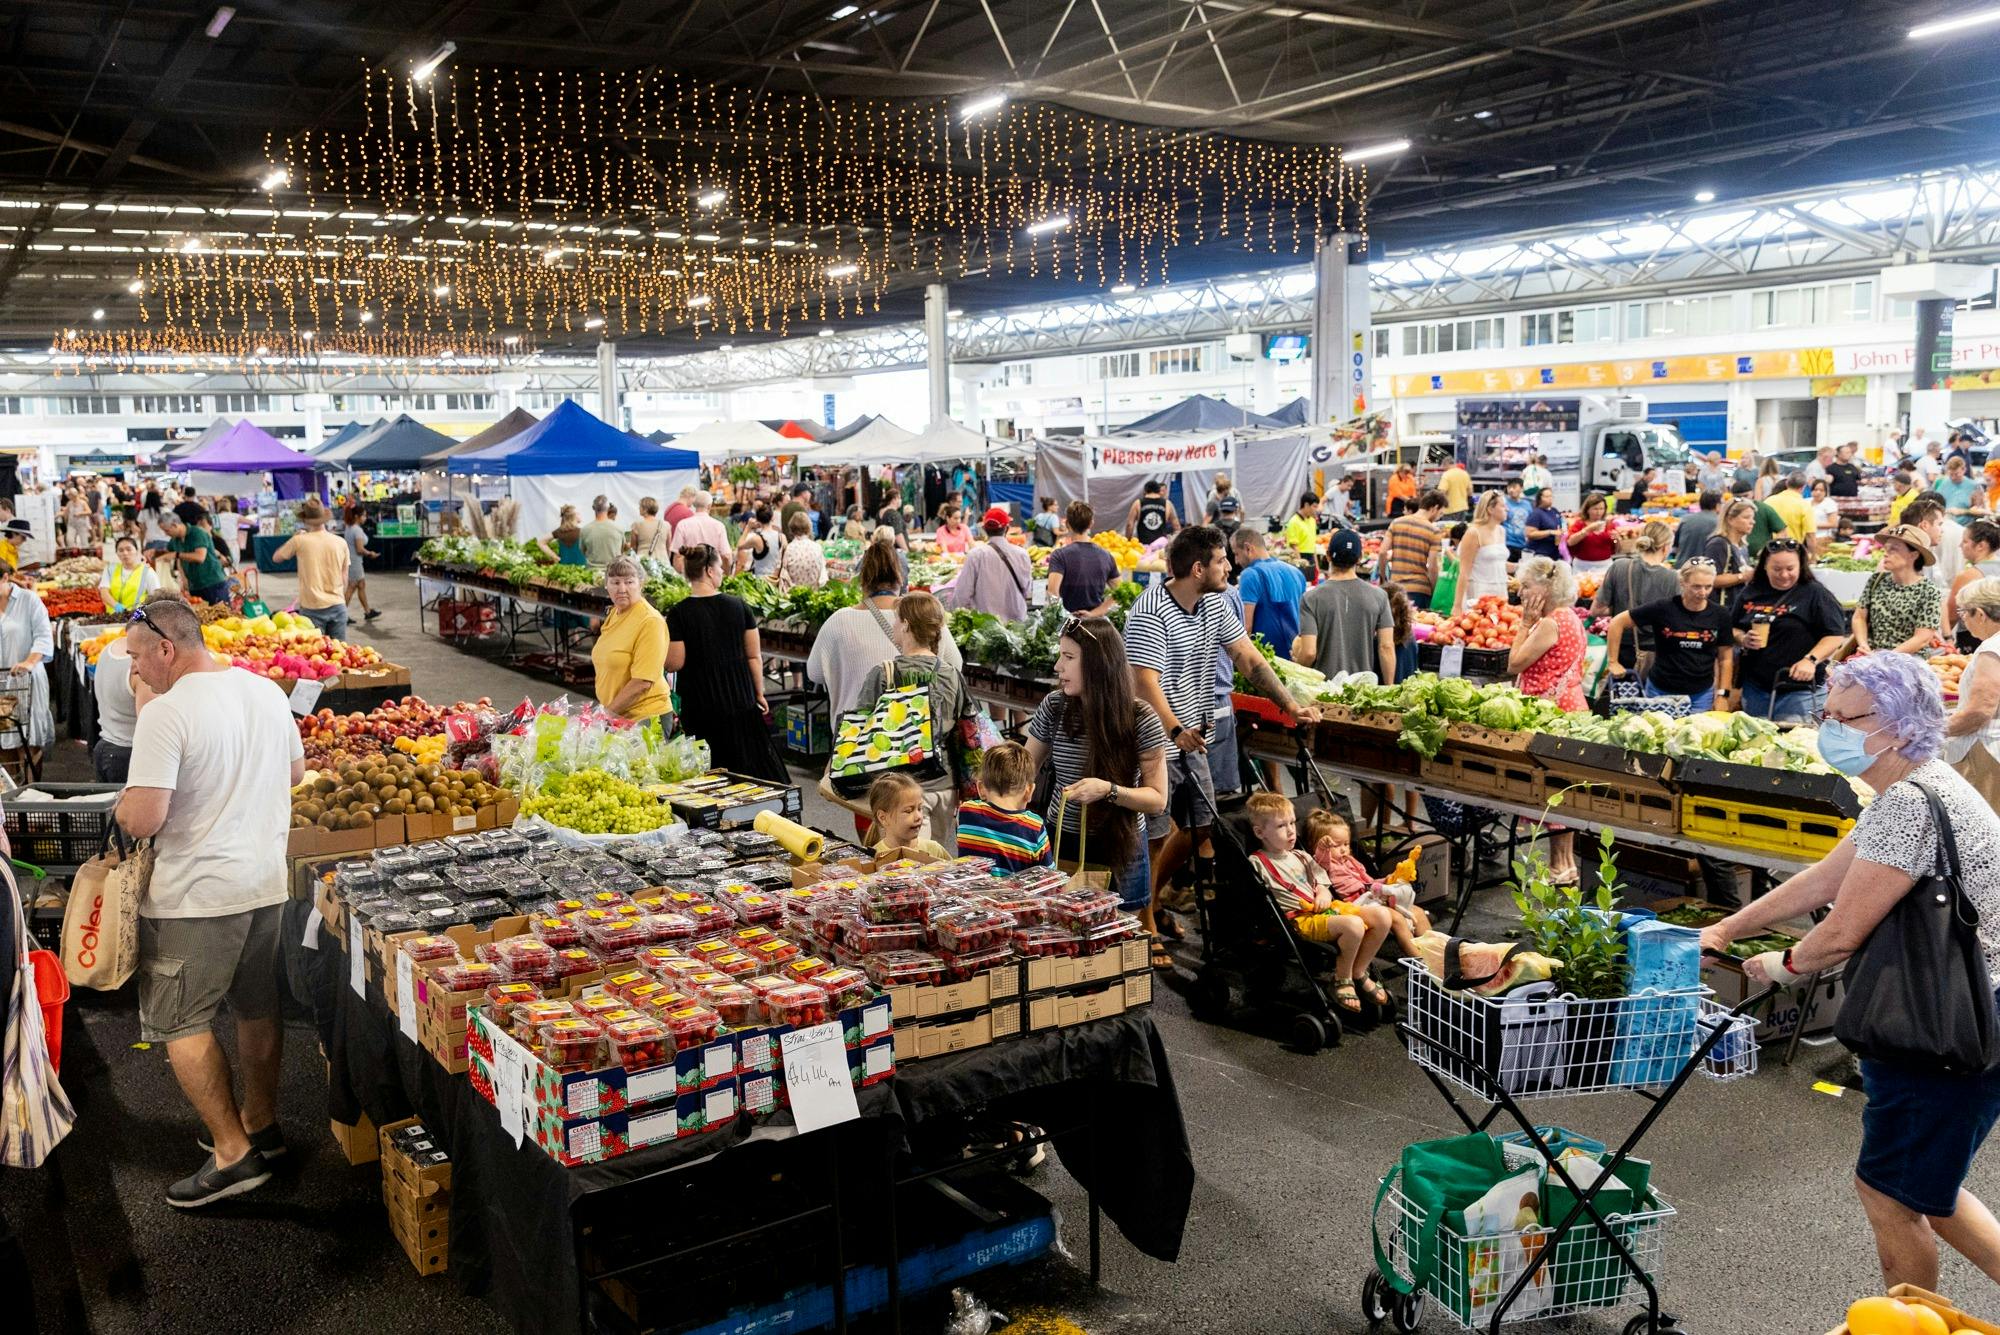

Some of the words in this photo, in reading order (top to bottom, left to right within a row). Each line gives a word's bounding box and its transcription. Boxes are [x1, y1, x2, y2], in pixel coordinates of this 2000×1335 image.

[1850, 350, 1898, 370] John
[1103, 447, 1154, 464] Please
[1157, 447, 1183, 463] Pay
[1184, 443, 1217, 460] Here
[1312, 445, 1332, 463] G
[1766, 1001, 1819, 1029] RUGY
[745, 1037, 762, 1045] CLASS
[571, 1080, 590, 1089] CLASS
[572, 1125, 591, 1134] CLASS
